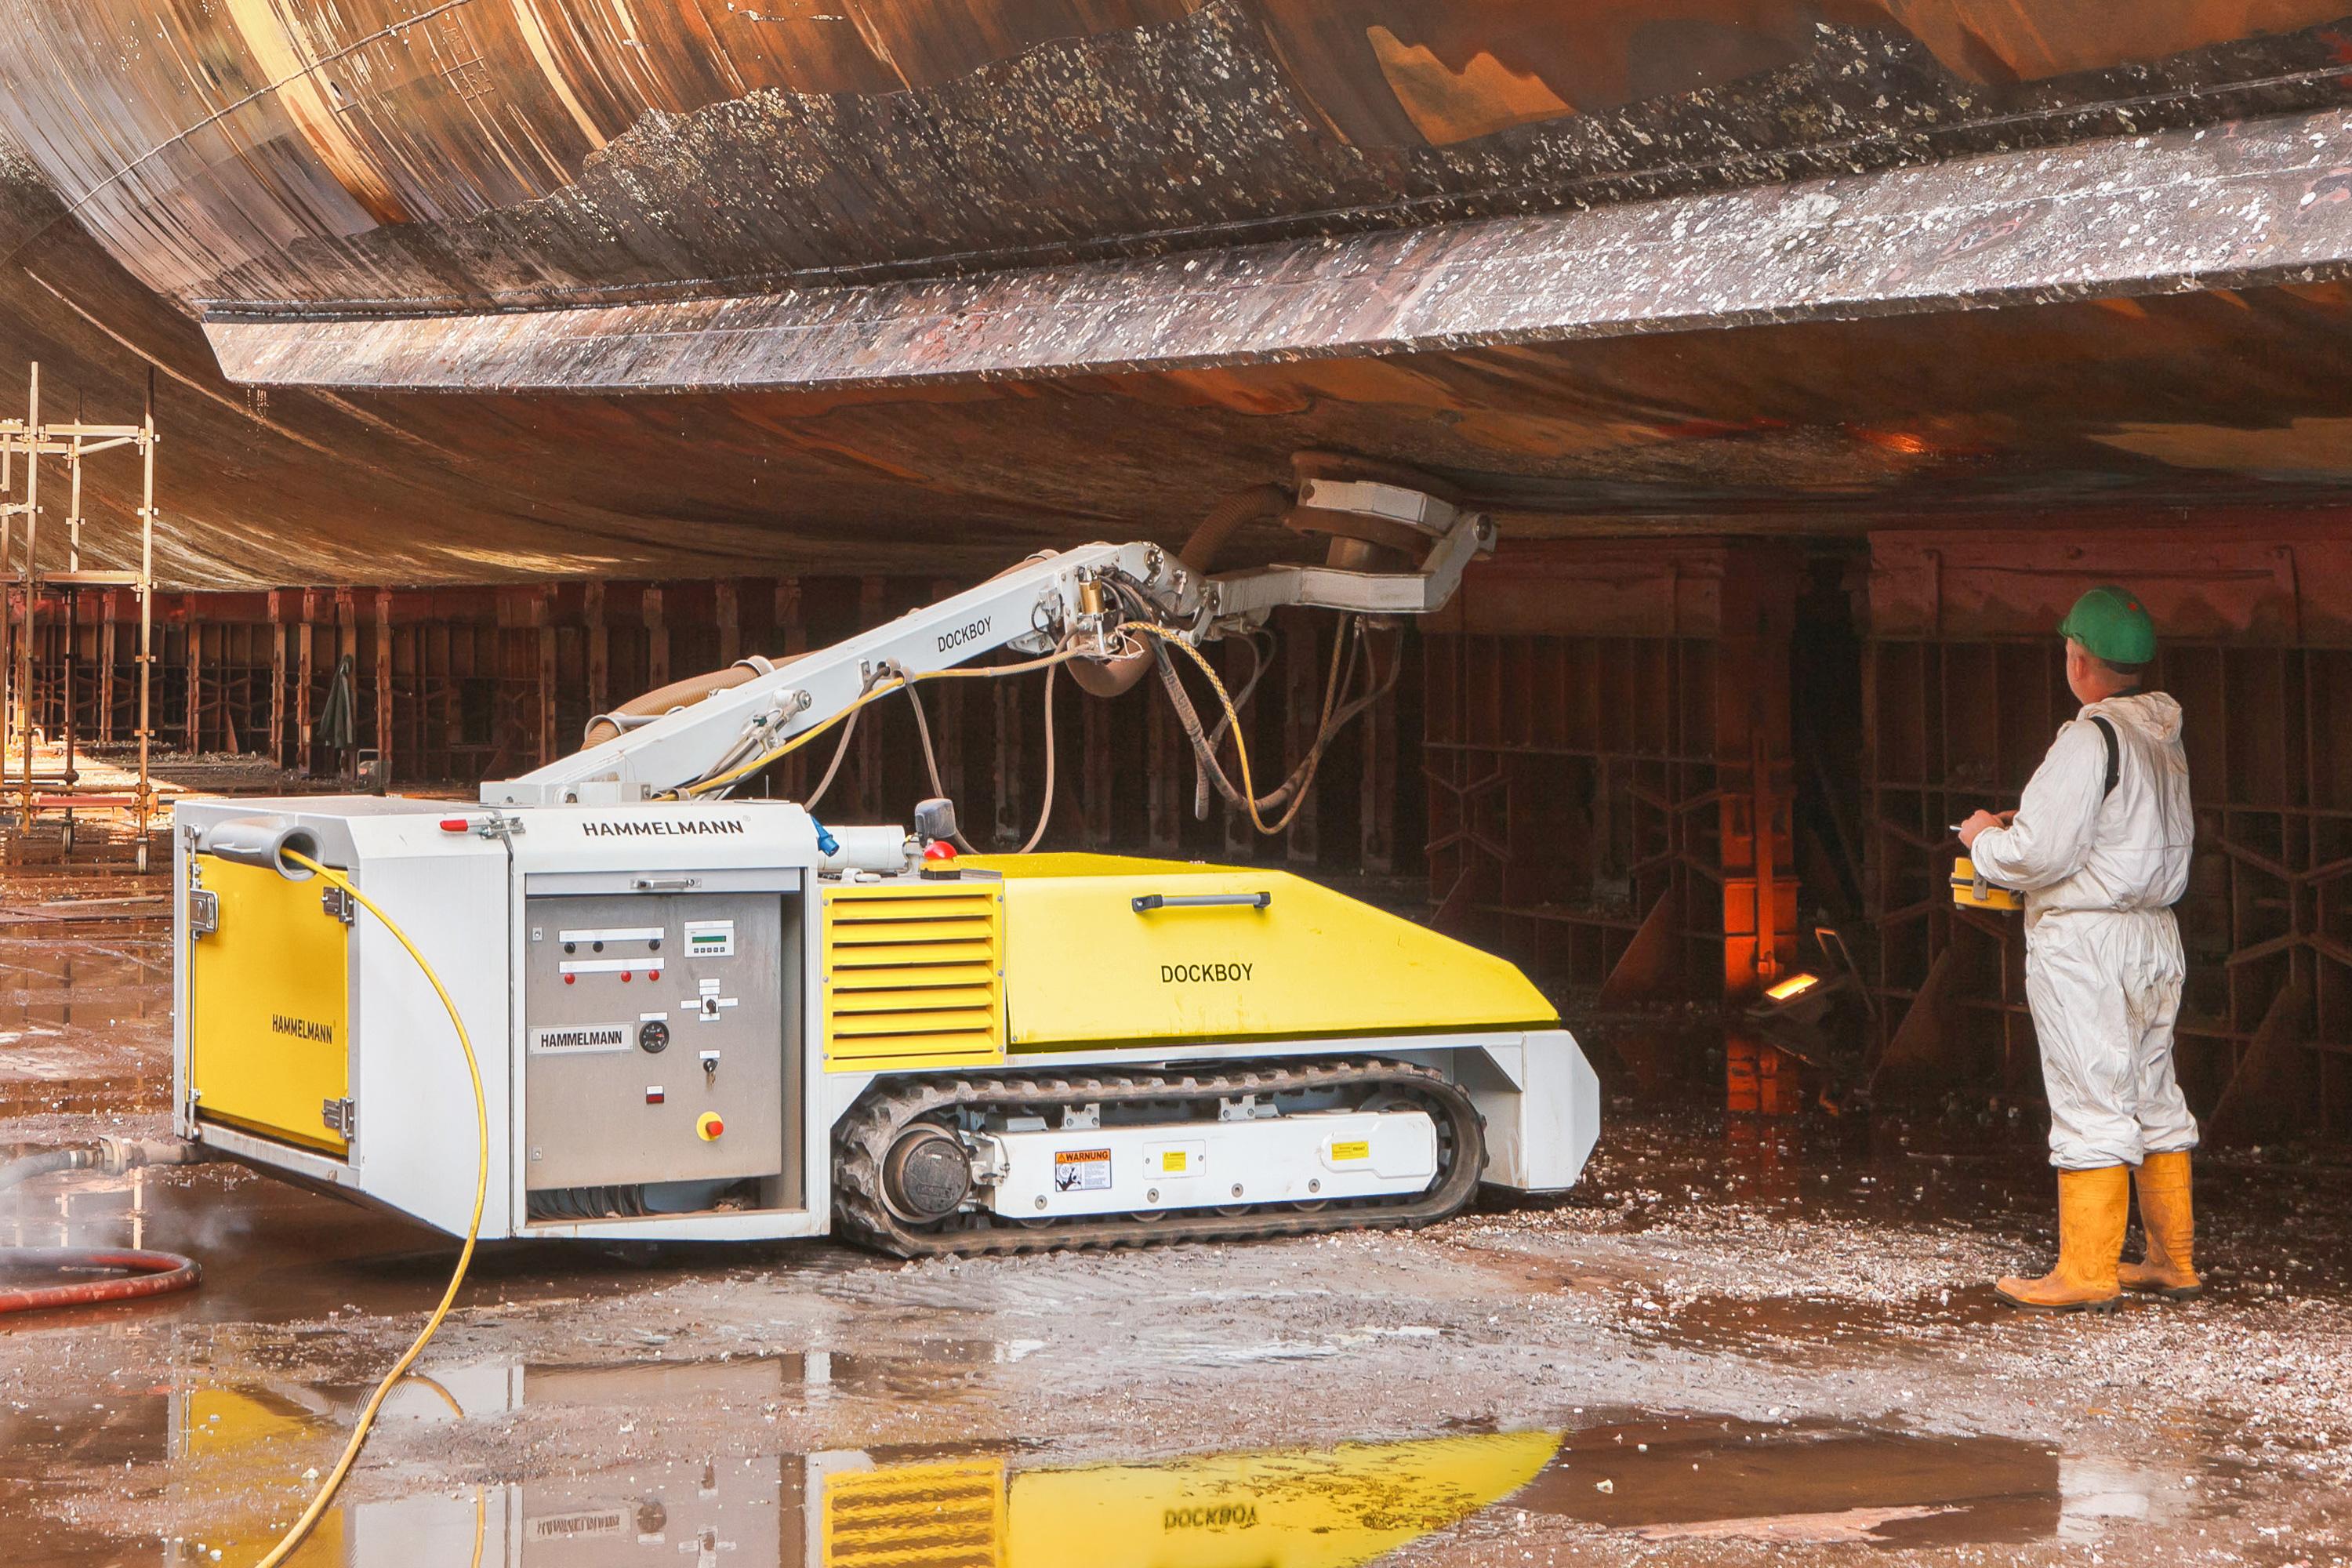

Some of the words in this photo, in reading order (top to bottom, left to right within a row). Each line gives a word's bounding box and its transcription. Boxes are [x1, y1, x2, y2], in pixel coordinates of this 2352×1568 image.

[938, 615, 991, 652] DOCKBOY
[582, 820, 745, 837] HAMMELMANN
[1161, 963, 1253, 982] DOCKBOY
[272, 1014, 332, 1045] HAMMELMANN
[541, 1030, 622, 1047] HAMMELMANN
[1066, 1151, 1108, 1161] WARNUNG
